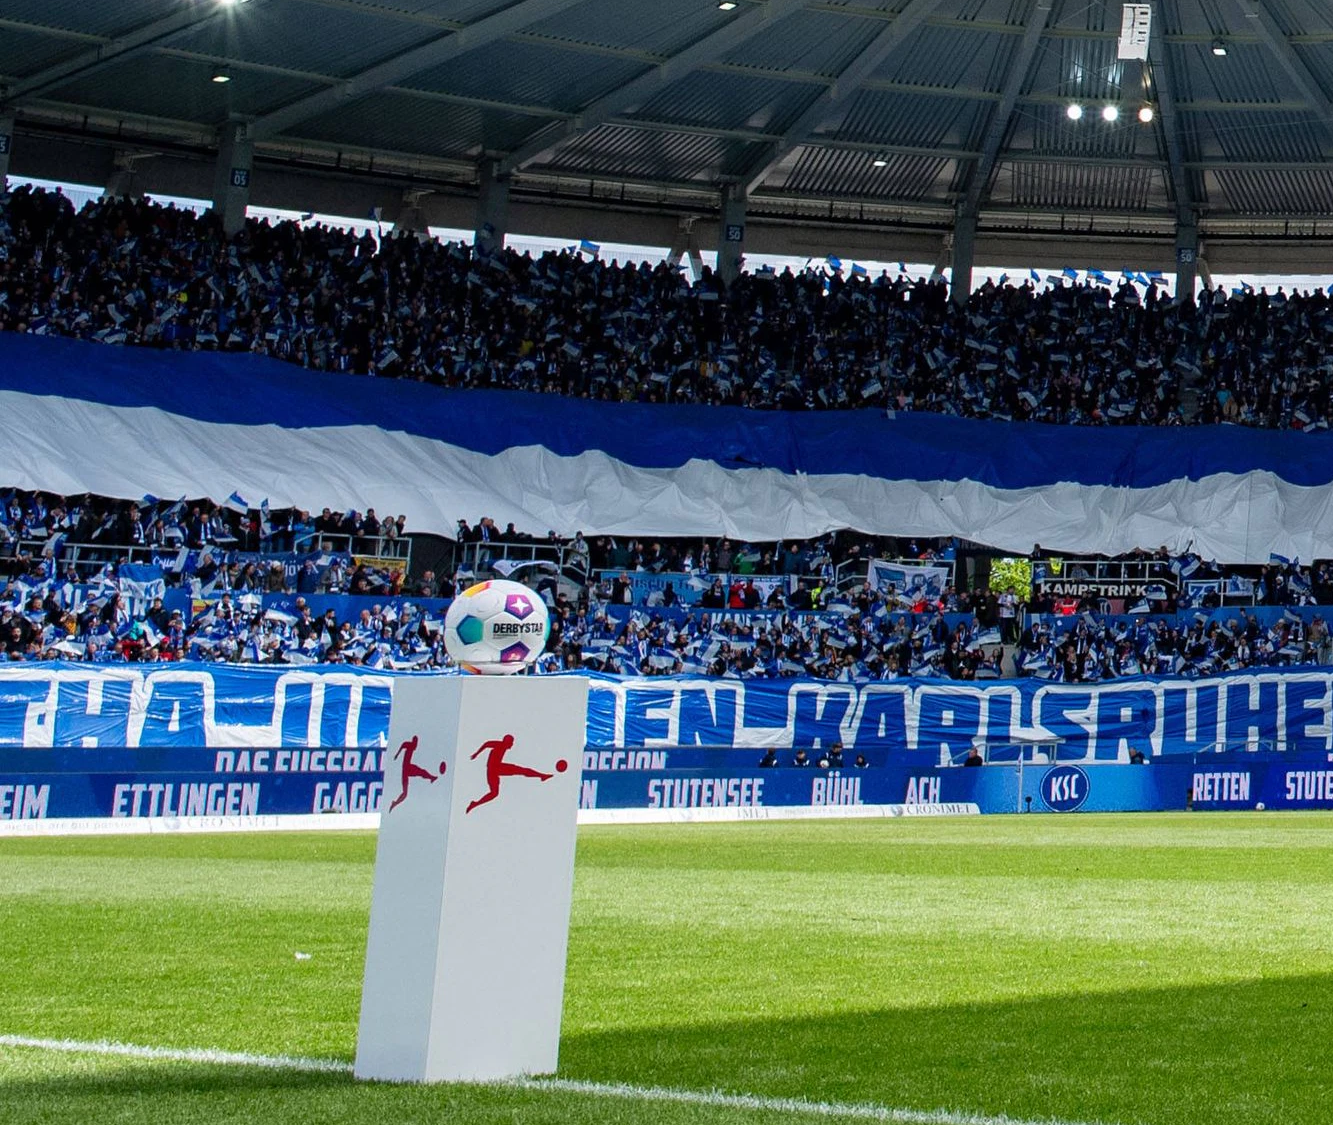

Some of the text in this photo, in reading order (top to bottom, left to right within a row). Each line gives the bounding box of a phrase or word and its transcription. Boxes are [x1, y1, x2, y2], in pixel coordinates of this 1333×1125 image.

[493, 622, 543, 634] DERBYSTAR
[112, 782, 260, 817] ETTLINGEN
[647, 772, 941, 808] STUTENSEE BÜHL ACH
[1050, 775, 1080, 802] KSC
[1192, 771, 1250, 801] RETTEN
[906, 803, 970, 815] CRONIMET
